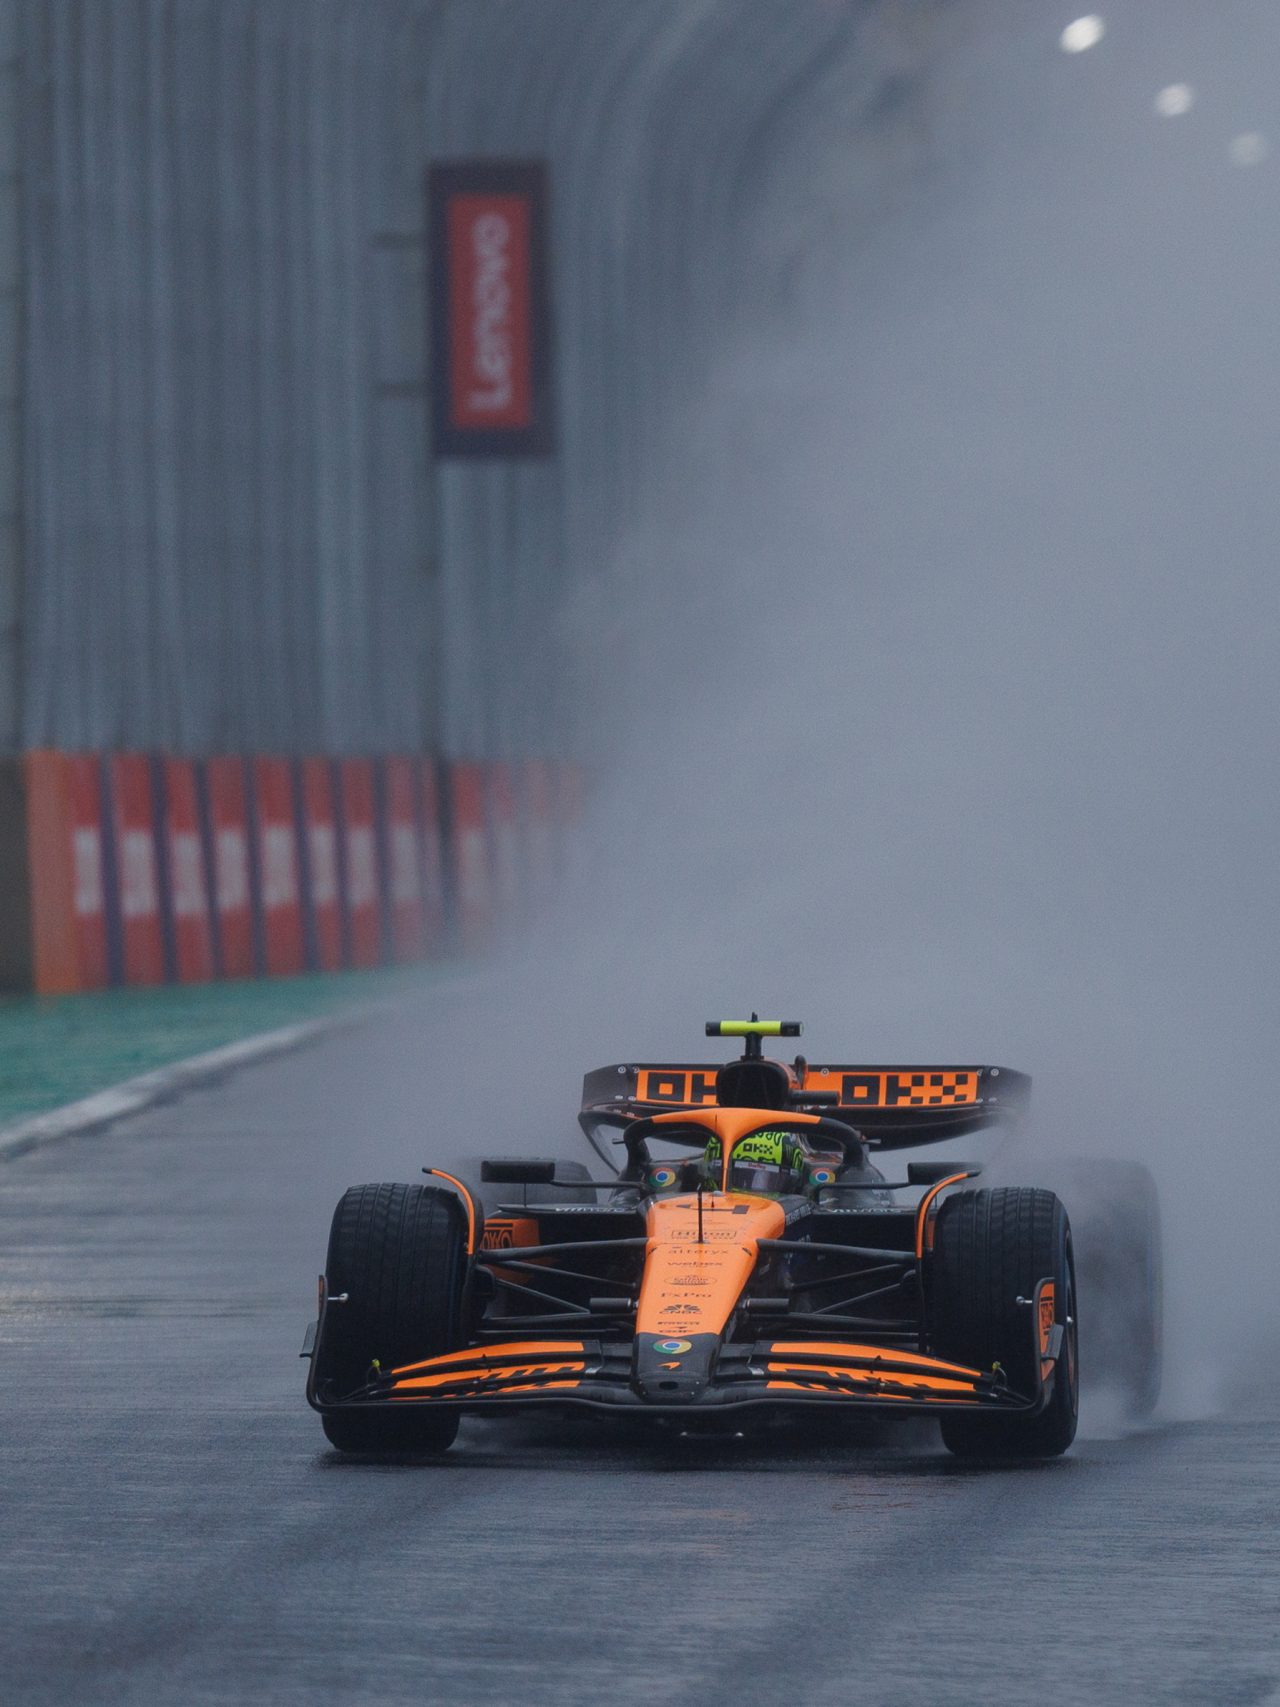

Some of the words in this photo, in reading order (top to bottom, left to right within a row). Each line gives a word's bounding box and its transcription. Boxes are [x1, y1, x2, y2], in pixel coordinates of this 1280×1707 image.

[468, 212, 511, 409] Lenovo
[647, 1072, 717, 1103] OK
[841, 1073, 968, 1106] OKX
[742, 1142, 773, 1155] OKX
